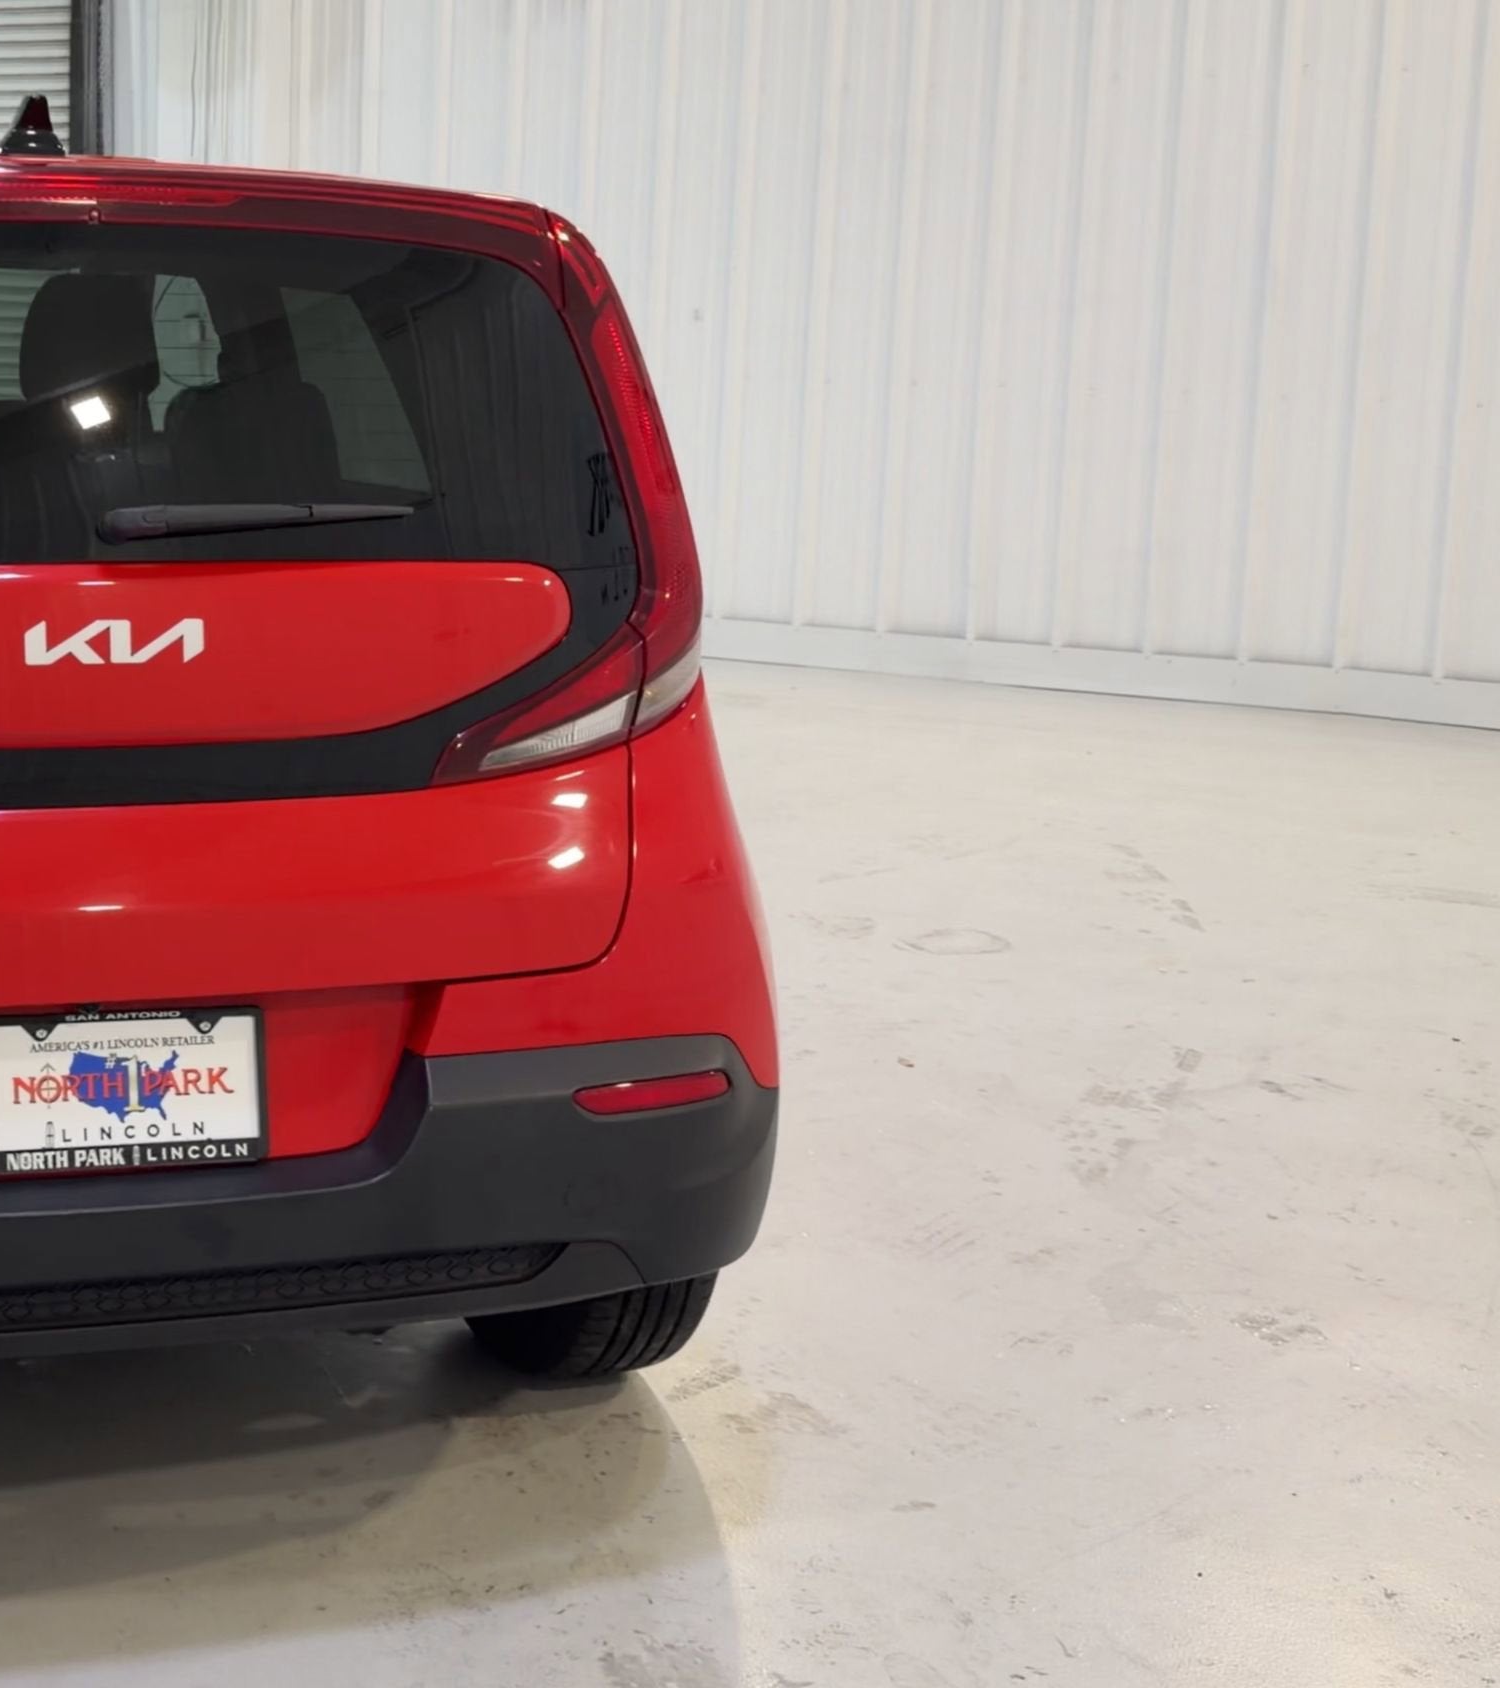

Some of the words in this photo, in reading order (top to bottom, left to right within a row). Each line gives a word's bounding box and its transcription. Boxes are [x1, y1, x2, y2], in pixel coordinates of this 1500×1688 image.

[24, 618, 204, 666] KIA
[64, 1013, 100, 1022] SAN
[105, 1010, 181, 1020] ANTONIO
[30, 1040, 90, 1053] AMERICA'S
[93, 1039, 105, 1050] #1
[108, 1037, 160, 1050] LINCOLN
[162, 1035, 215, 1047] RETAILER
[12, 1071, 126, 1105] NORTH
[143, 1066, 235, 1096] PARK
[61, 1121, 205, 1143] LINCOLN
[6, 1150, 69, 1172] NORTH
[74, 1147, 126, 1168] PARK
[146, 1143, 249, 1162] LINCOLN
